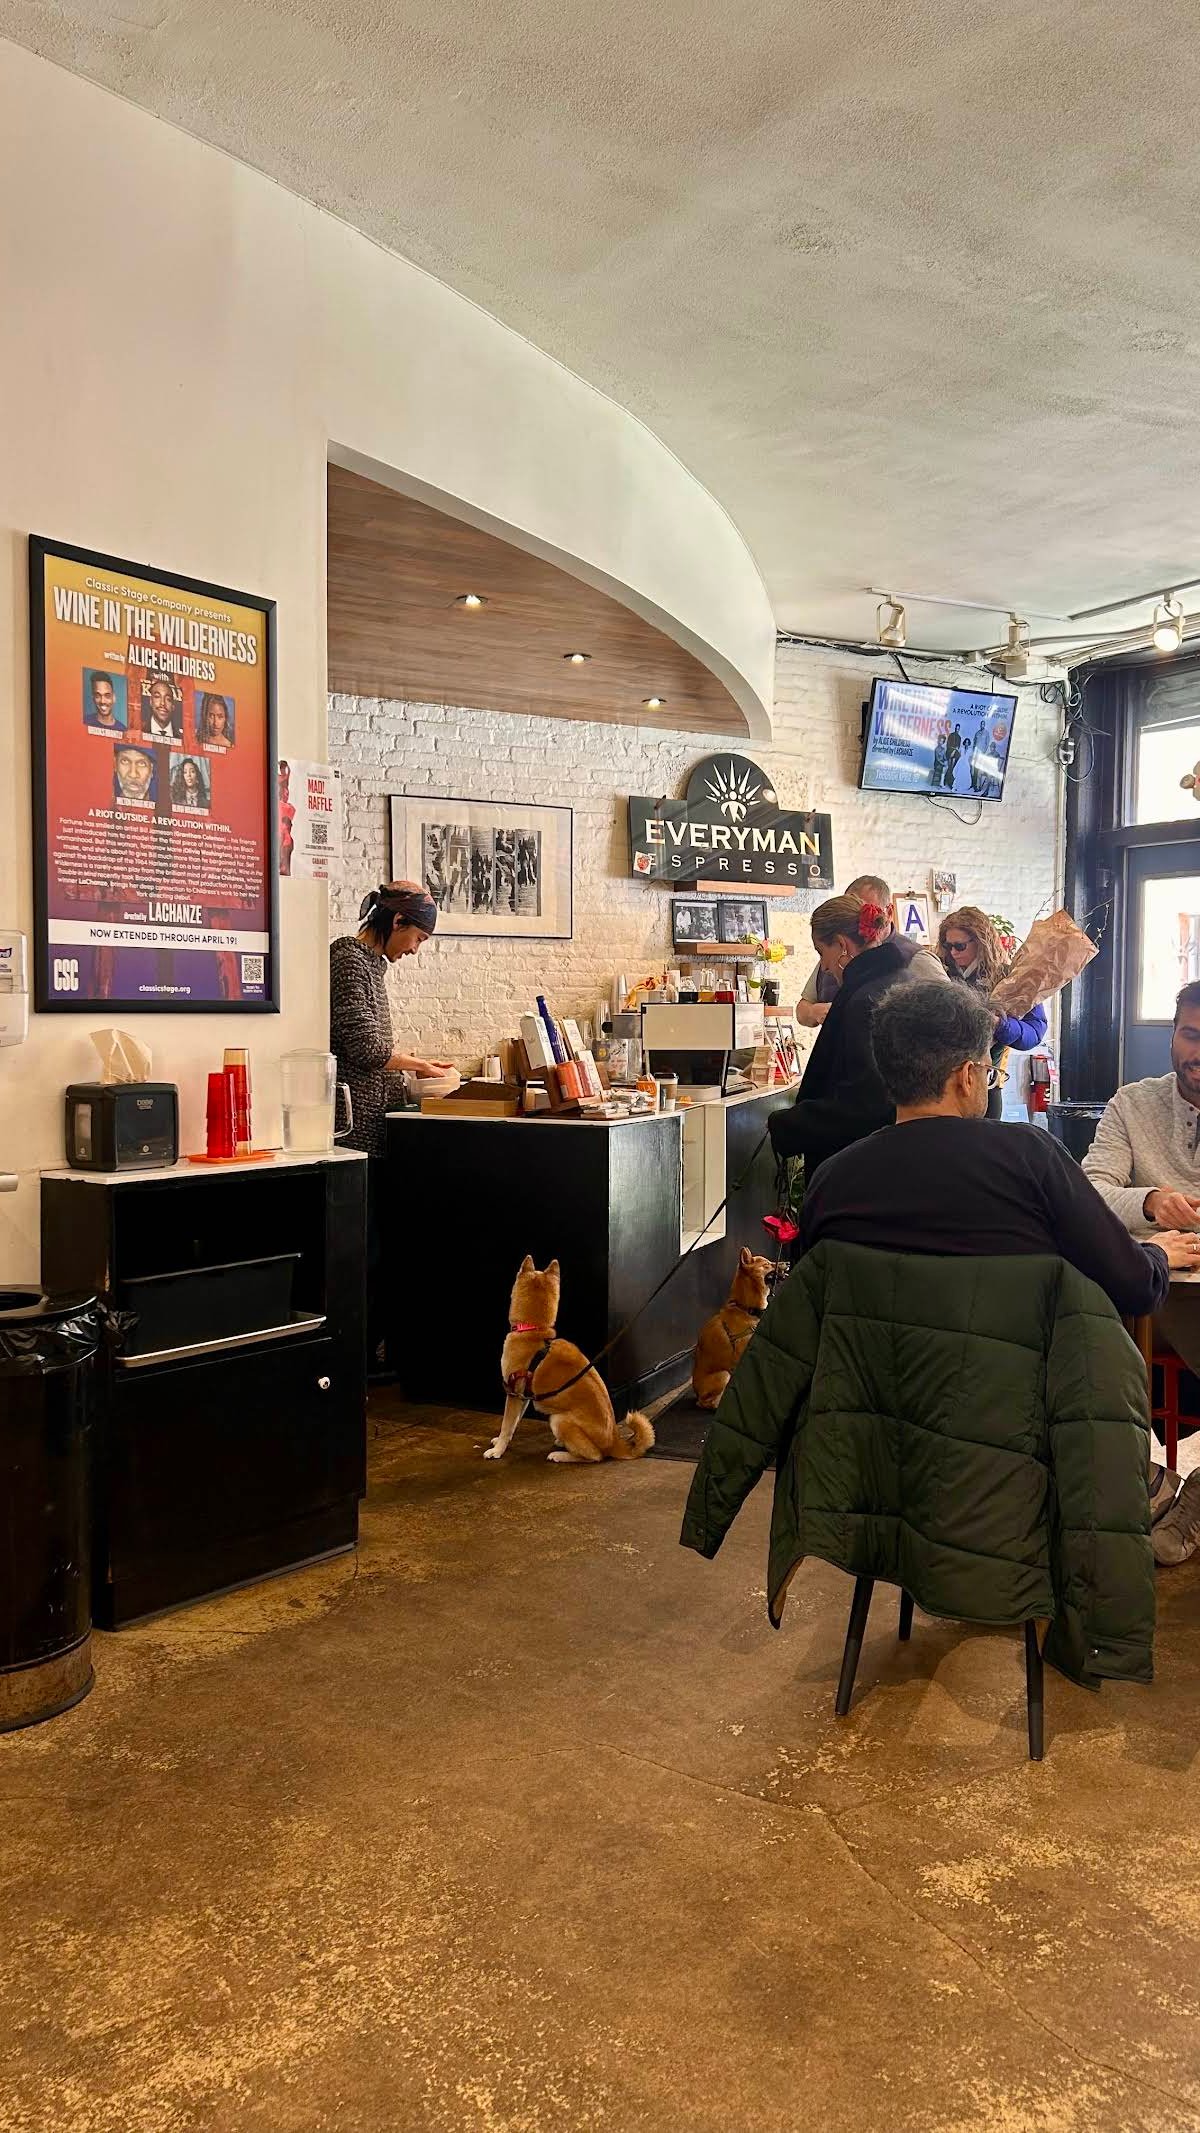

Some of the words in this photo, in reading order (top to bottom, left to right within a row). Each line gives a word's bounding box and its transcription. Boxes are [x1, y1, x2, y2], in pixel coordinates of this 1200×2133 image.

[85, 577, 119, 594] Classic
[121, 586, 148, 602] Stage
[150, 594, 192, 615] Company
[194, 607, 232, 623] presents
[54, 586, 100, 629] WINE
[104, 600, 120, 634] IN
[124, 604, 155, 642] THE
[158, 612, 257, 665] WILDERNESS
[128, 644, 158, 669] ALICE
[160, 650, 215, 682] CHILDRESS
[153, 672, 169, 681] with
[957, 709, 989, 718] REVOLUTIO
[874, 711, 952, 741] WILDERNESS
[308, 779, 325, 795] MAD!
[308, 796, 333, 812] RAFFLE
[96, 810, 114, 818] RIOT
[115, 812, 150, 823] OUTSIDE.
[158, 817, 203, 829] REVOLUTION
[205, 823, 231, 833] WITHIN.
[645, 819, 820, 856] EVERYMAN
[149, 902, 202, 924] LACHANZE
[906, 905, 924, 931] A
[90, 928, 111, 938] NOW
[113, 930, 157, 941] EXTENDED
[160, 933, 200, 943] THROUGH
[202, 935, 224, 944] APRIL
[226, 936, 238, 945] 19!
[54, 958, 79, 991] CSC
[139, 984, 191, 994] classicstage.org
